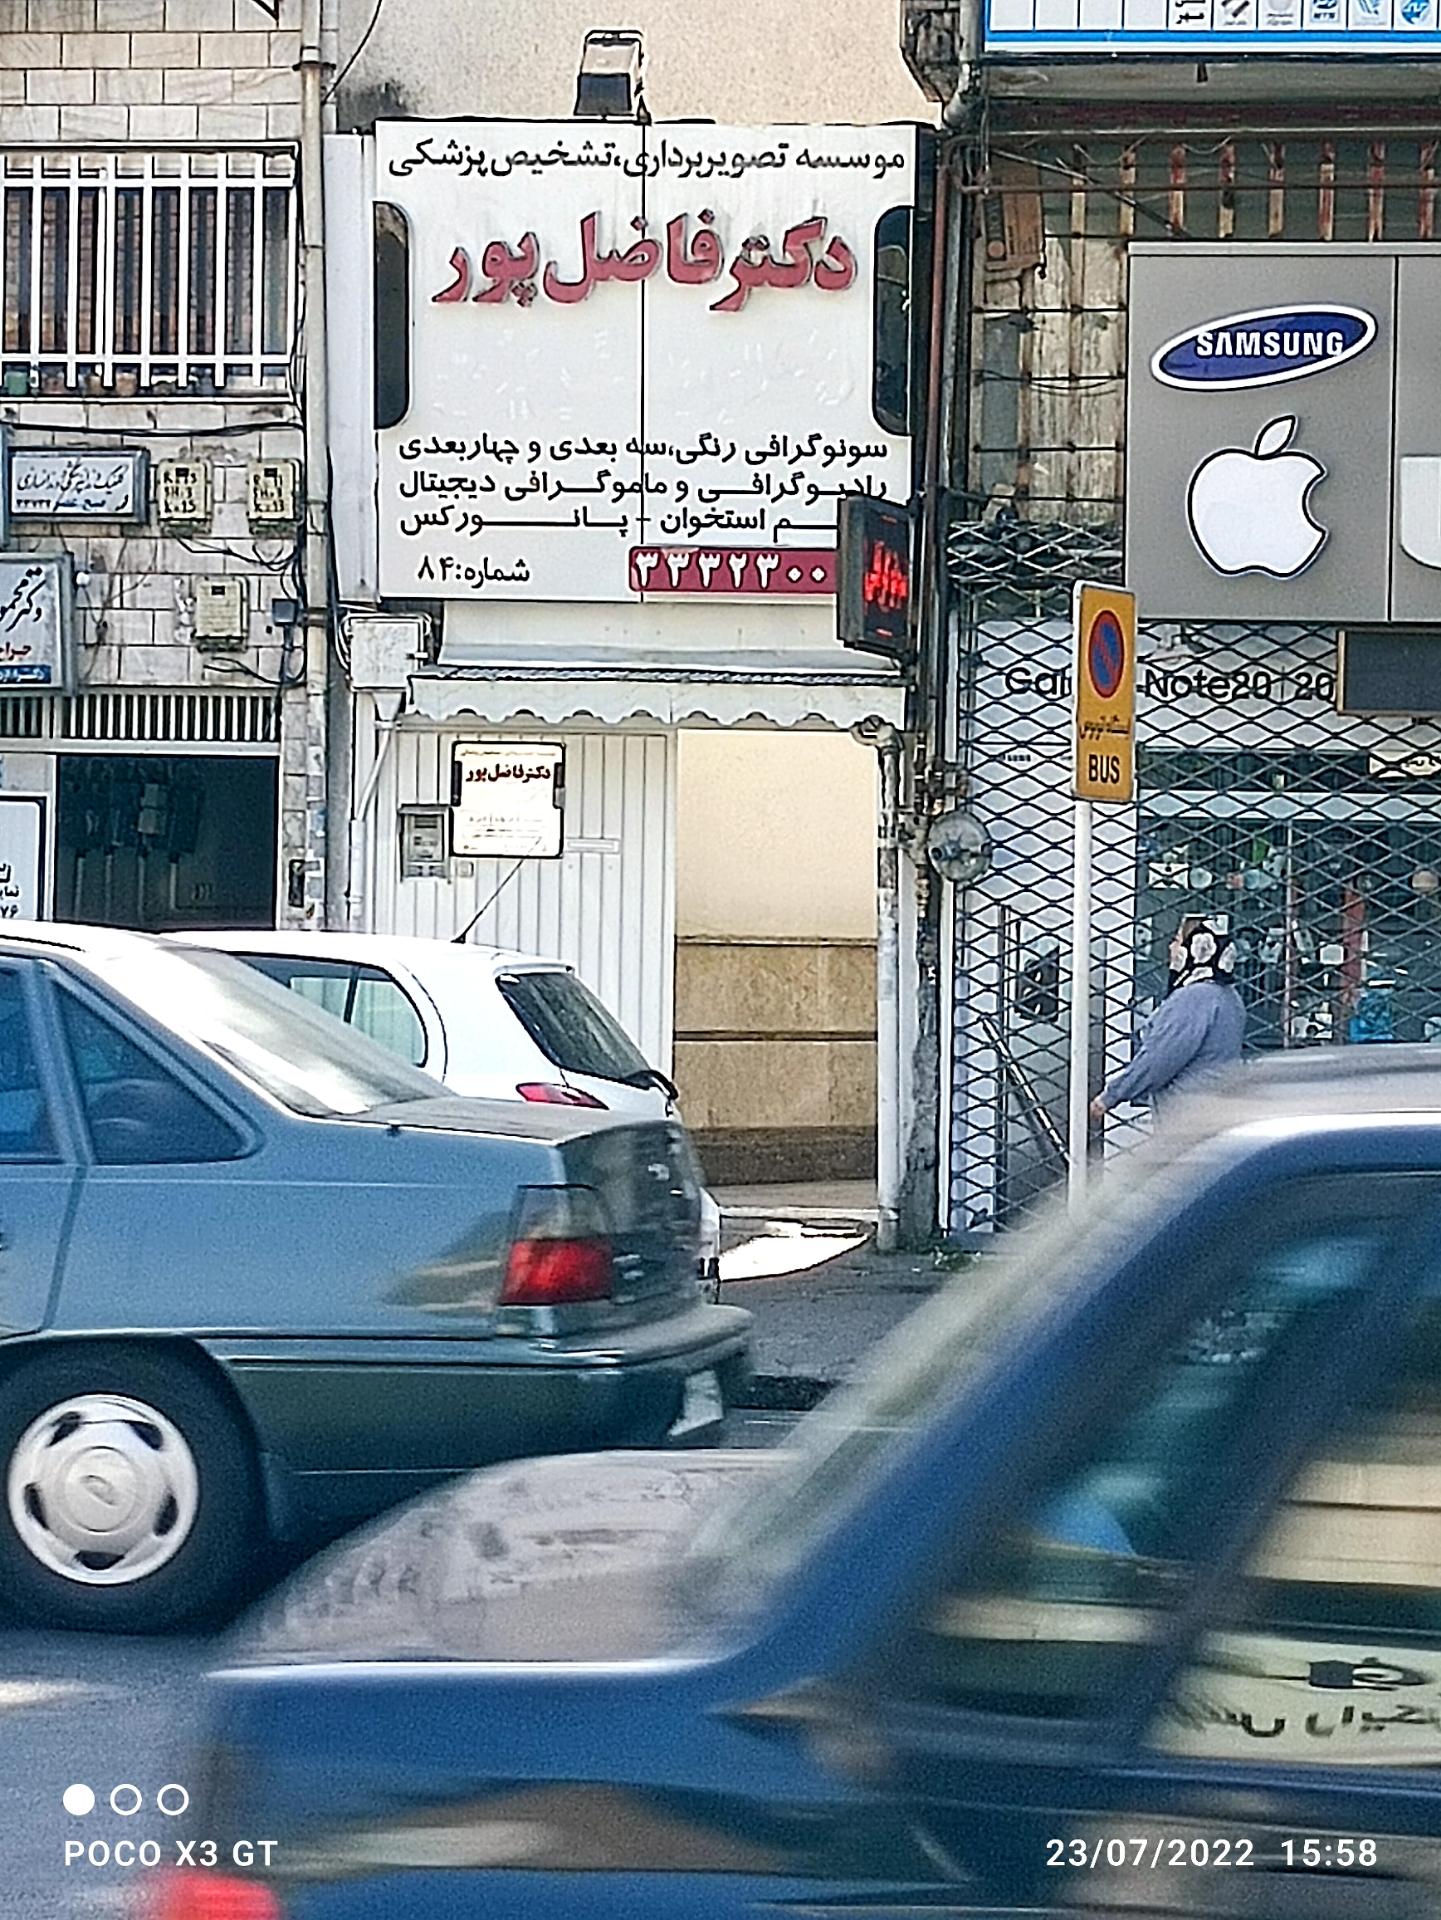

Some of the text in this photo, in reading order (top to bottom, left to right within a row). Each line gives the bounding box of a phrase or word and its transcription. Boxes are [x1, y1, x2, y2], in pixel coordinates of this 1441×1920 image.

[388, 137, 489, 177] پزشکی
[796, 148, 905, 179] موسسه
[709, 215, 858, 312] دکتر
[1196, 331, 1345, 357] SAMSUNG
[527, 440, 541, 464] و
[550, 437, 618, 463] بعدی
[745, 432, 888, 468] سونوگرافی
[400, 468, 888, 506] رادیوگرافی و ماموگرافی دیجیتال
[400, 504, 629, 538] پانورکس
[661, 506, 766, 538] استخوان
[1005, 666, 1071, 697] Gal
[1145, 669, 1271, 700] Note20
[1088, 754, 1120, 785] BUS
